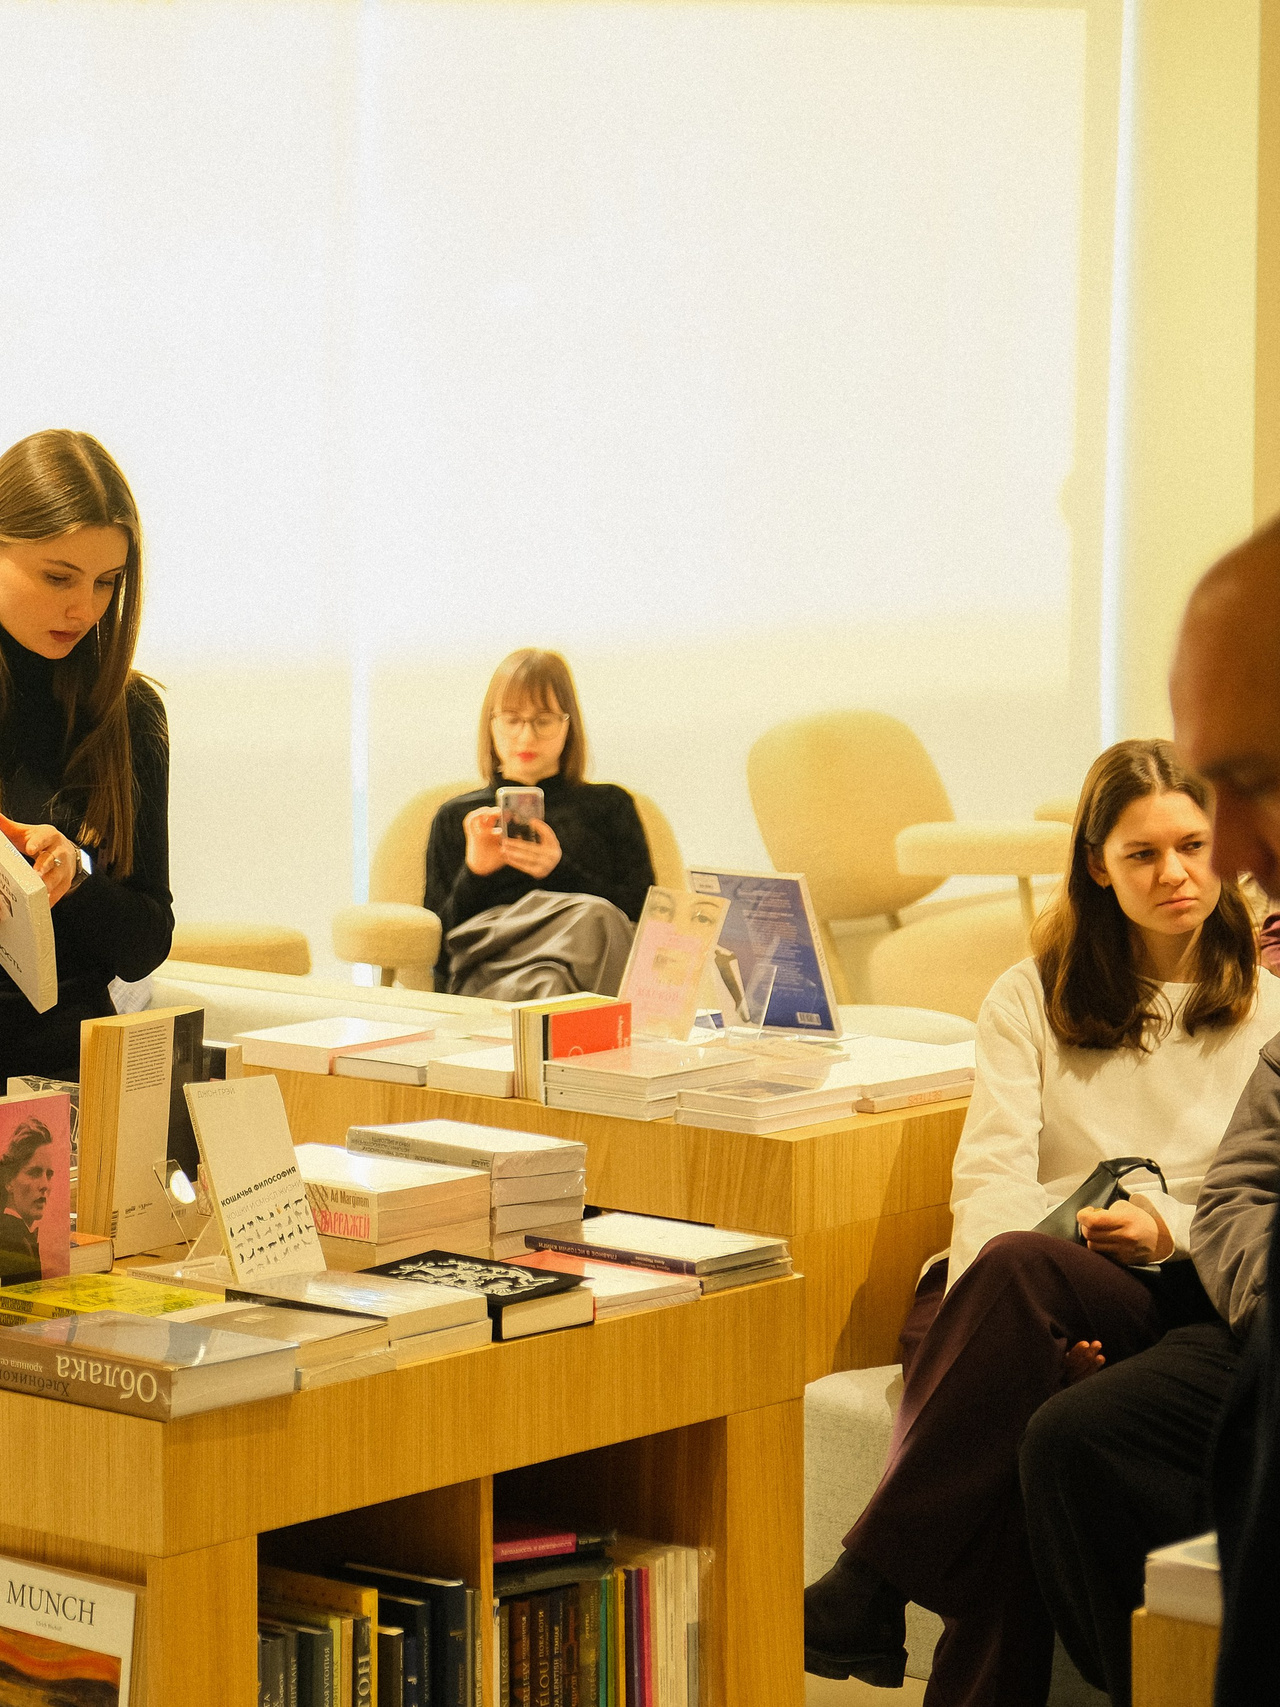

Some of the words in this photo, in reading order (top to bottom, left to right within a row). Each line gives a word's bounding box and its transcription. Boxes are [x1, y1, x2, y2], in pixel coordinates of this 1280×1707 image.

[220, 1187, 253, 1208] КОШАЧЬЯ
[253, 1166, 297, 1191] ФИЛОСОФИЯ
[331, 1189, 339, 1203] Ad
[340, 1190, 370, 1209] Marginem
[10, 1359, 44, 1373] хроника
[55, 1355, 158, 1403] Облака
[6, 1580, 96, 1627] MUNCH
